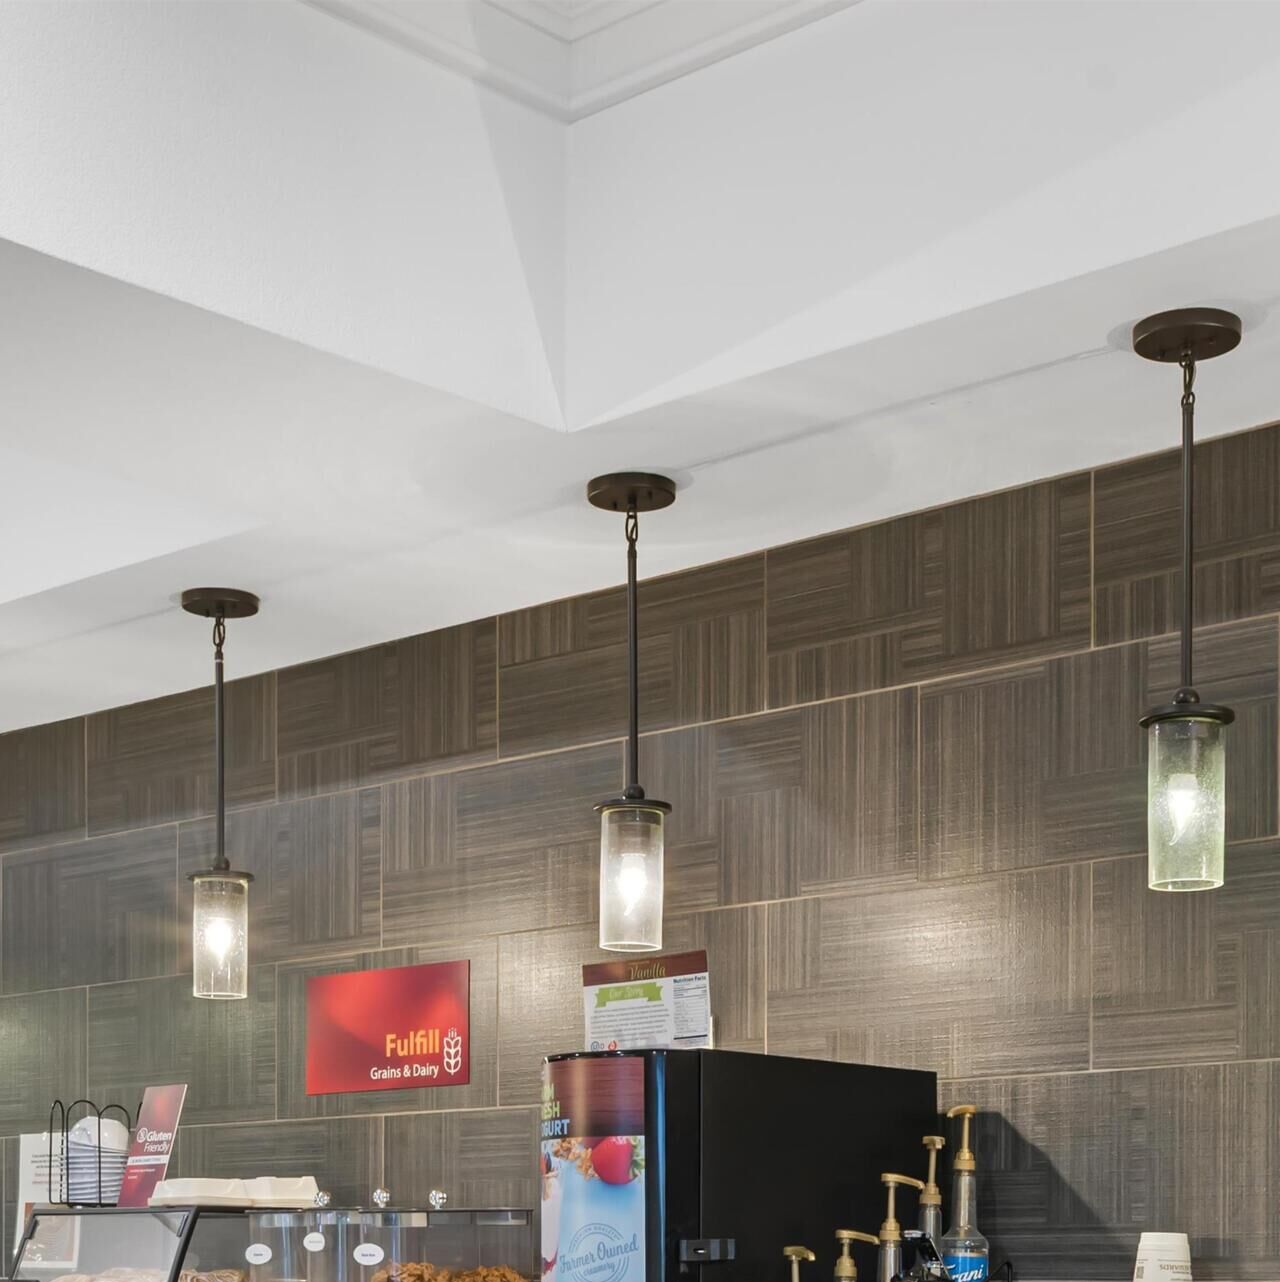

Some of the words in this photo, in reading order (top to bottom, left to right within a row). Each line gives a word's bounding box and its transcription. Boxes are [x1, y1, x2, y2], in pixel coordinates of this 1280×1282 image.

[630, 961, 666, 980] Vanilla
[385, 1028, 440, 1058] Fulfill
[370, 1066, 401, 1080] Grains
[403, 1064, 411, 1078] &
[413, 1062, 439, 1079] Dairy
[147, 1131, 172, 1142] Gluten
[143, 1142, 170, 1154] Friendly
[559, 1251, 596, 1274] Farmer
[597, 1232, 639, 1261] Owned
